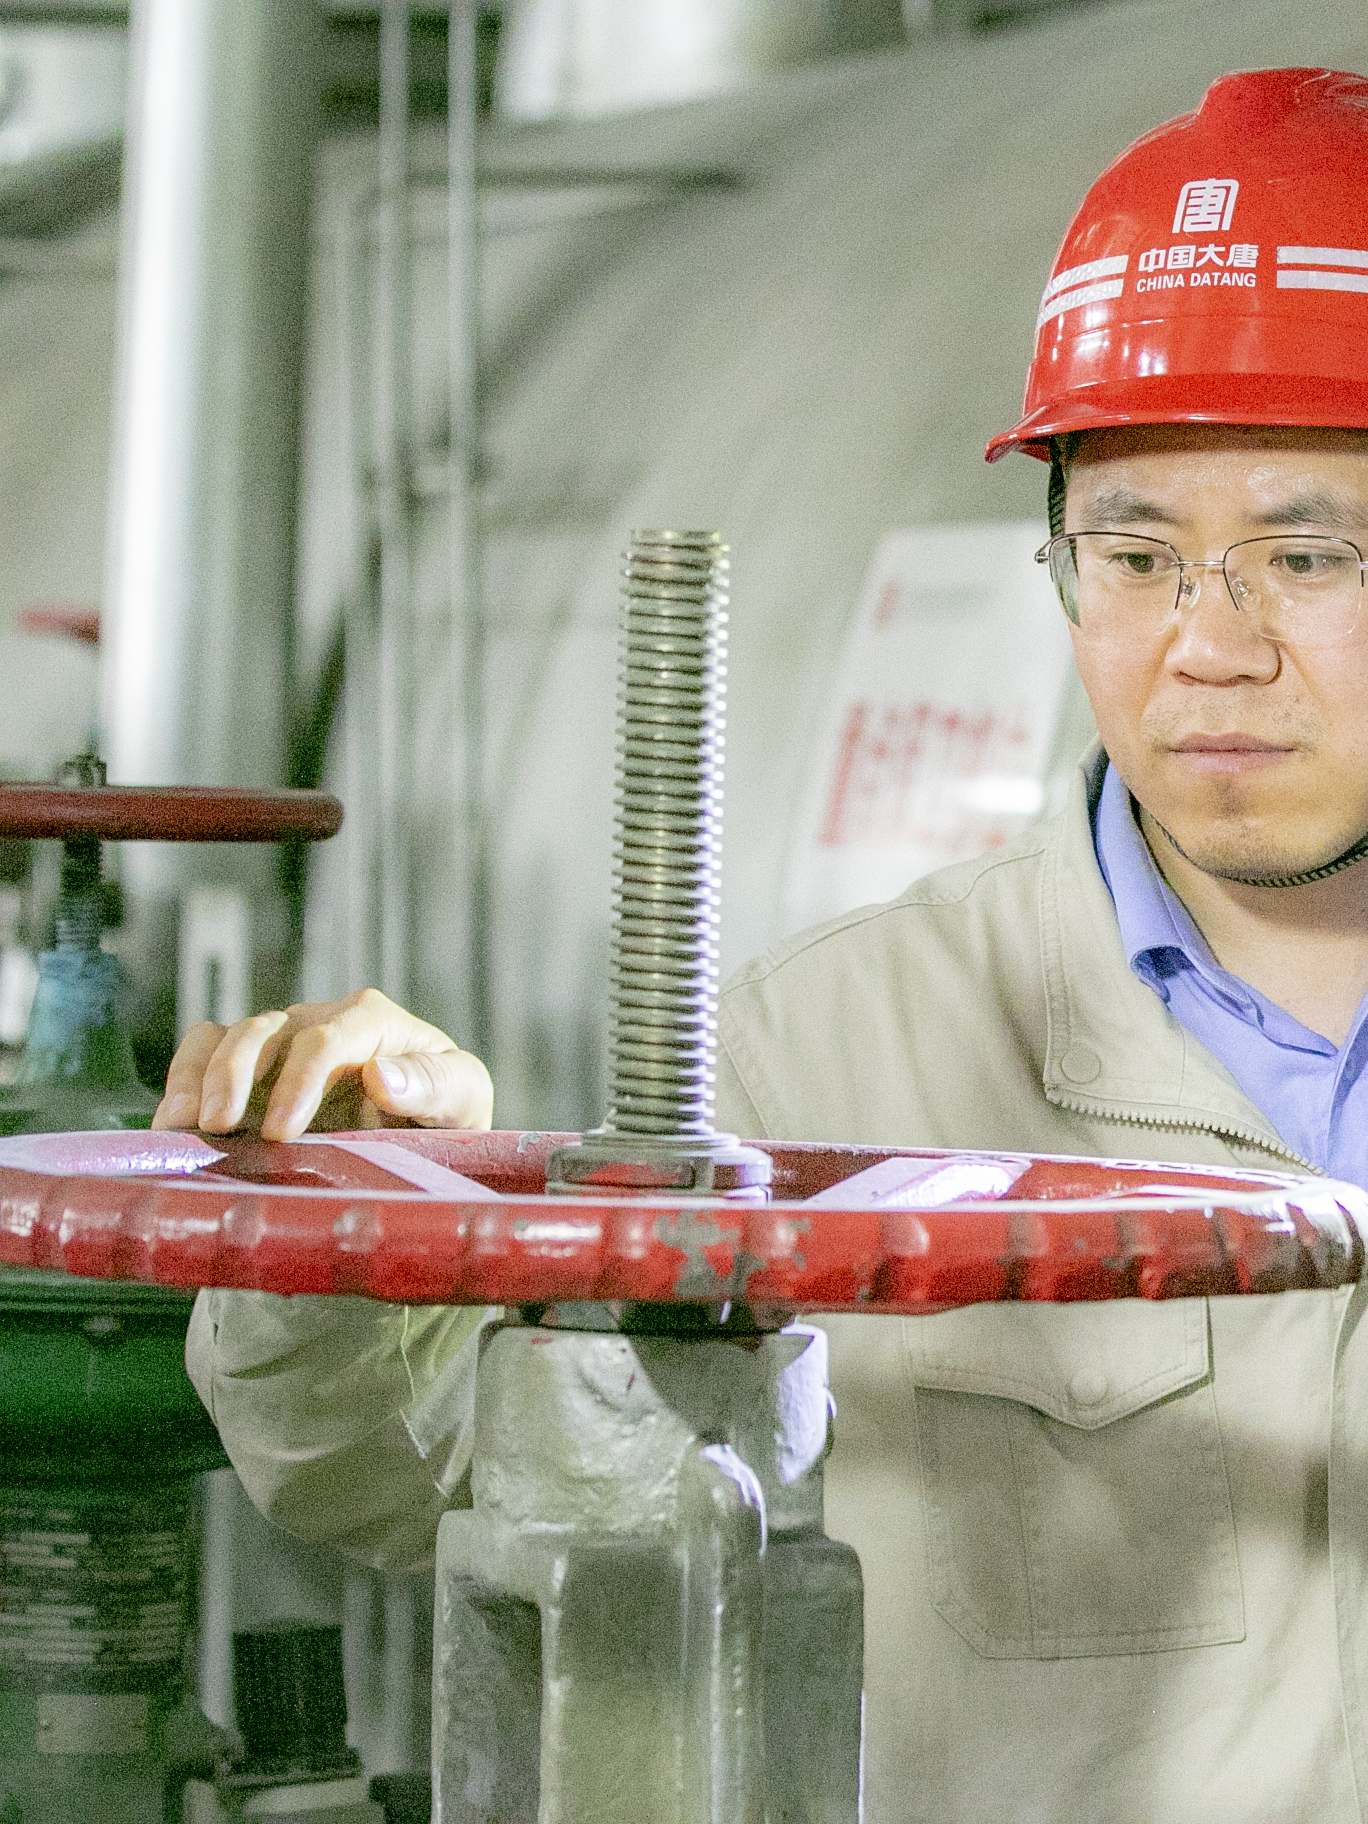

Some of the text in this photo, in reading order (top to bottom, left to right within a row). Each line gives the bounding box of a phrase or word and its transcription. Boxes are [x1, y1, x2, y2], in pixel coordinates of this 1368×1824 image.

[1138, 243, 1259, 272] 中国大唐
[1136, 272, 1257, 292] CHINA DATANG
